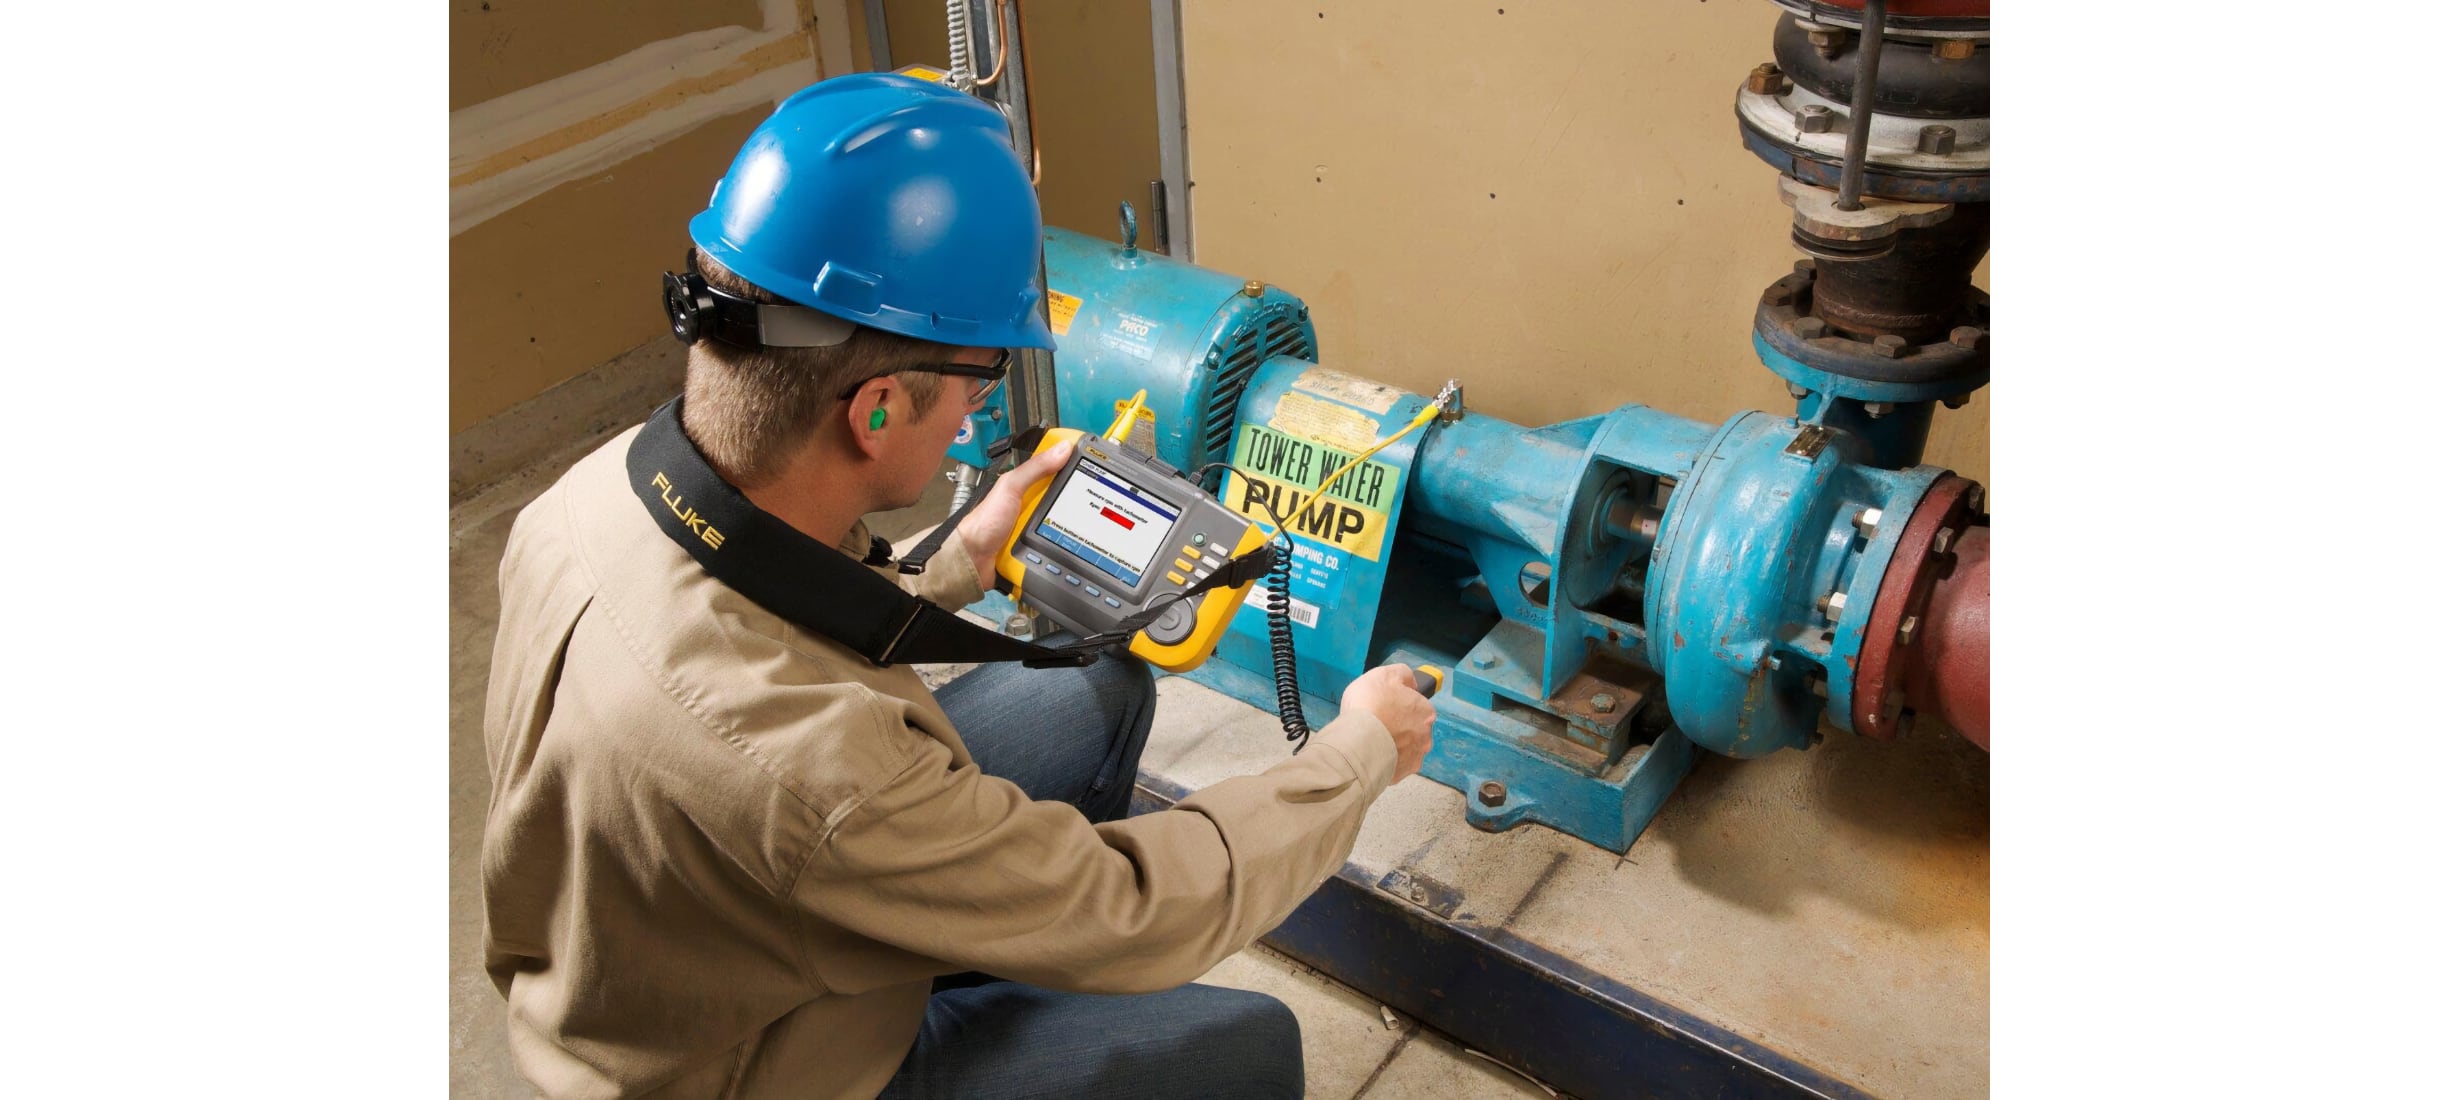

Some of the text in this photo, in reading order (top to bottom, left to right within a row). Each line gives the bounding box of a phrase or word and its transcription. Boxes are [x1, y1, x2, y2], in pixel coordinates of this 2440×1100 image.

[1246, 428, 1385, 507] TOWER WATER
[651, 472, 725, 550] FLUKE
[1242, 477, 1365, 543] PUMP
[1325, 555, 1339, 571] CO.
